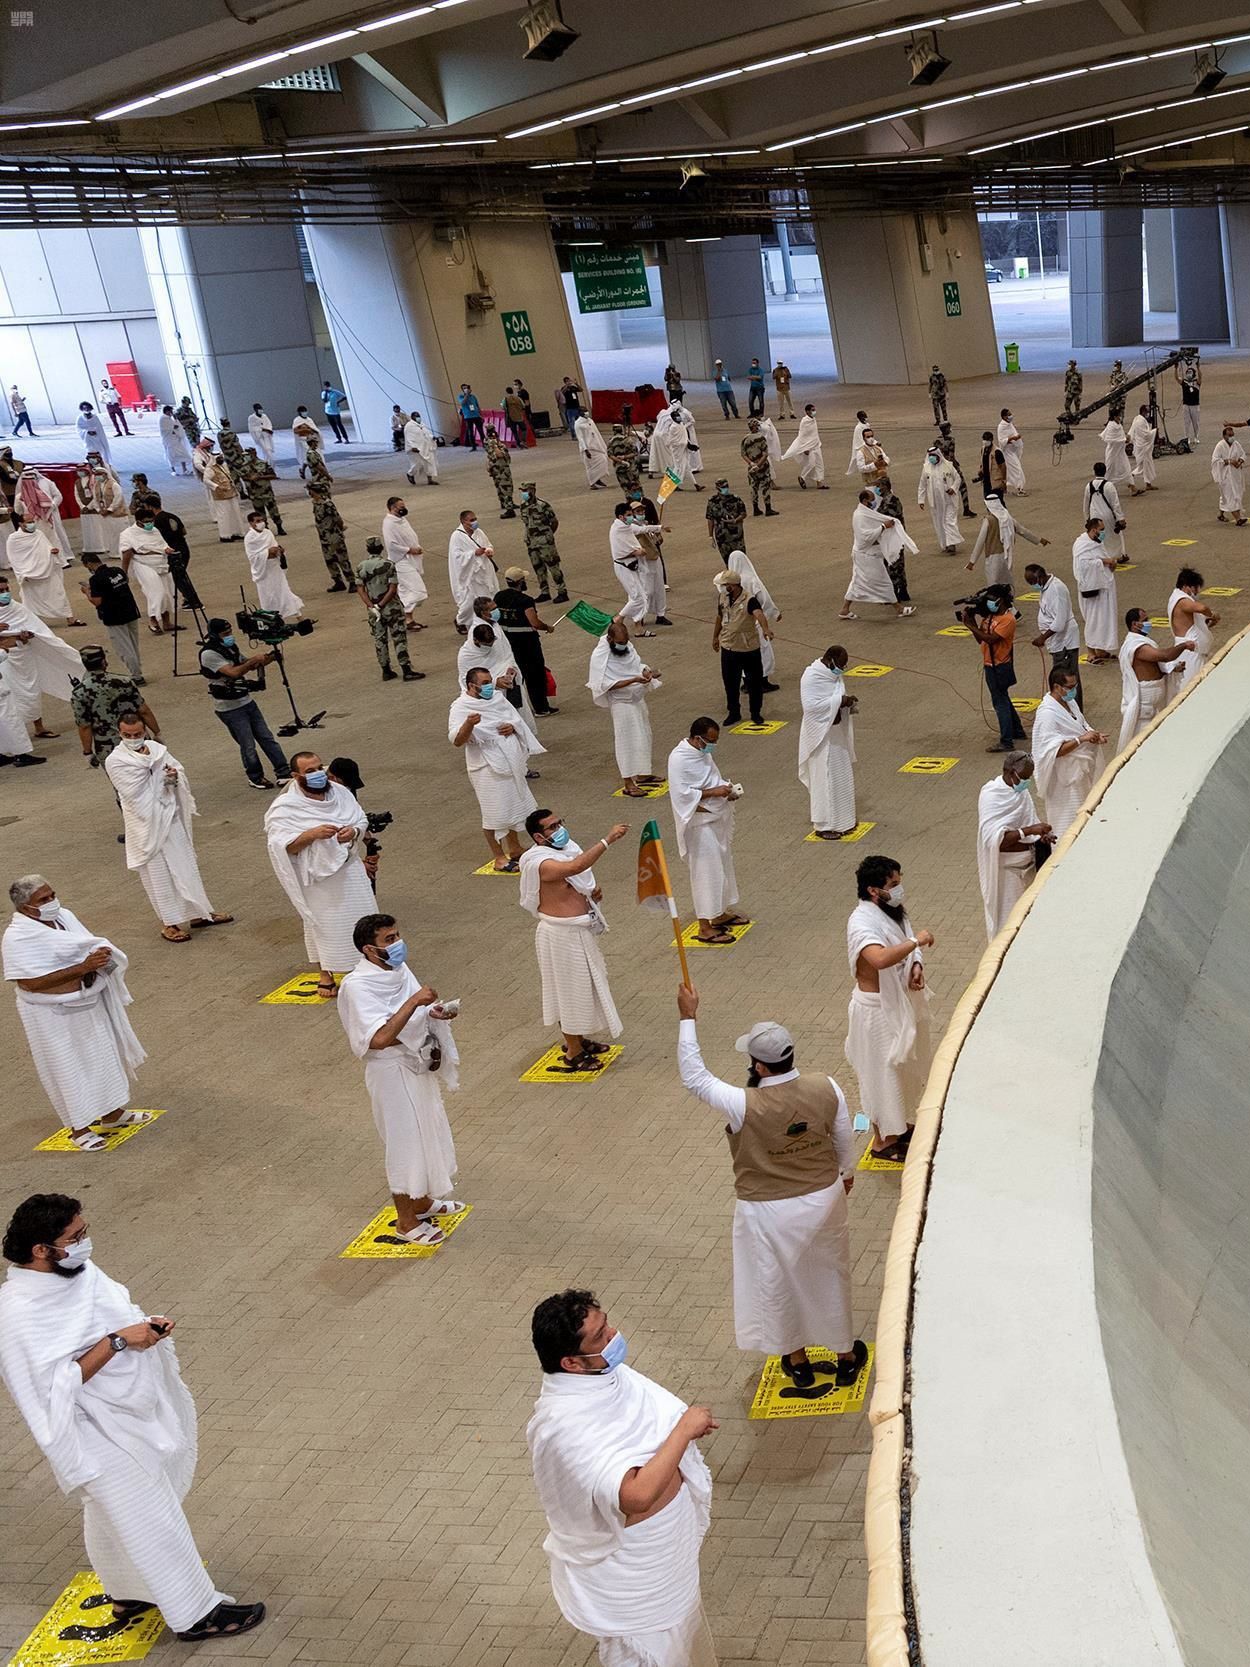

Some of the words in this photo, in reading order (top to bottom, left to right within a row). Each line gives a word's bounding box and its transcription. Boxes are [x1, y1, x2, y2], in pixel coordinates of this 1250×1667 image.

[947, 301, 960, 314] 060
[505, 314, 529, 333] ٠٥٨
[510, 335, 533, 352] 058
